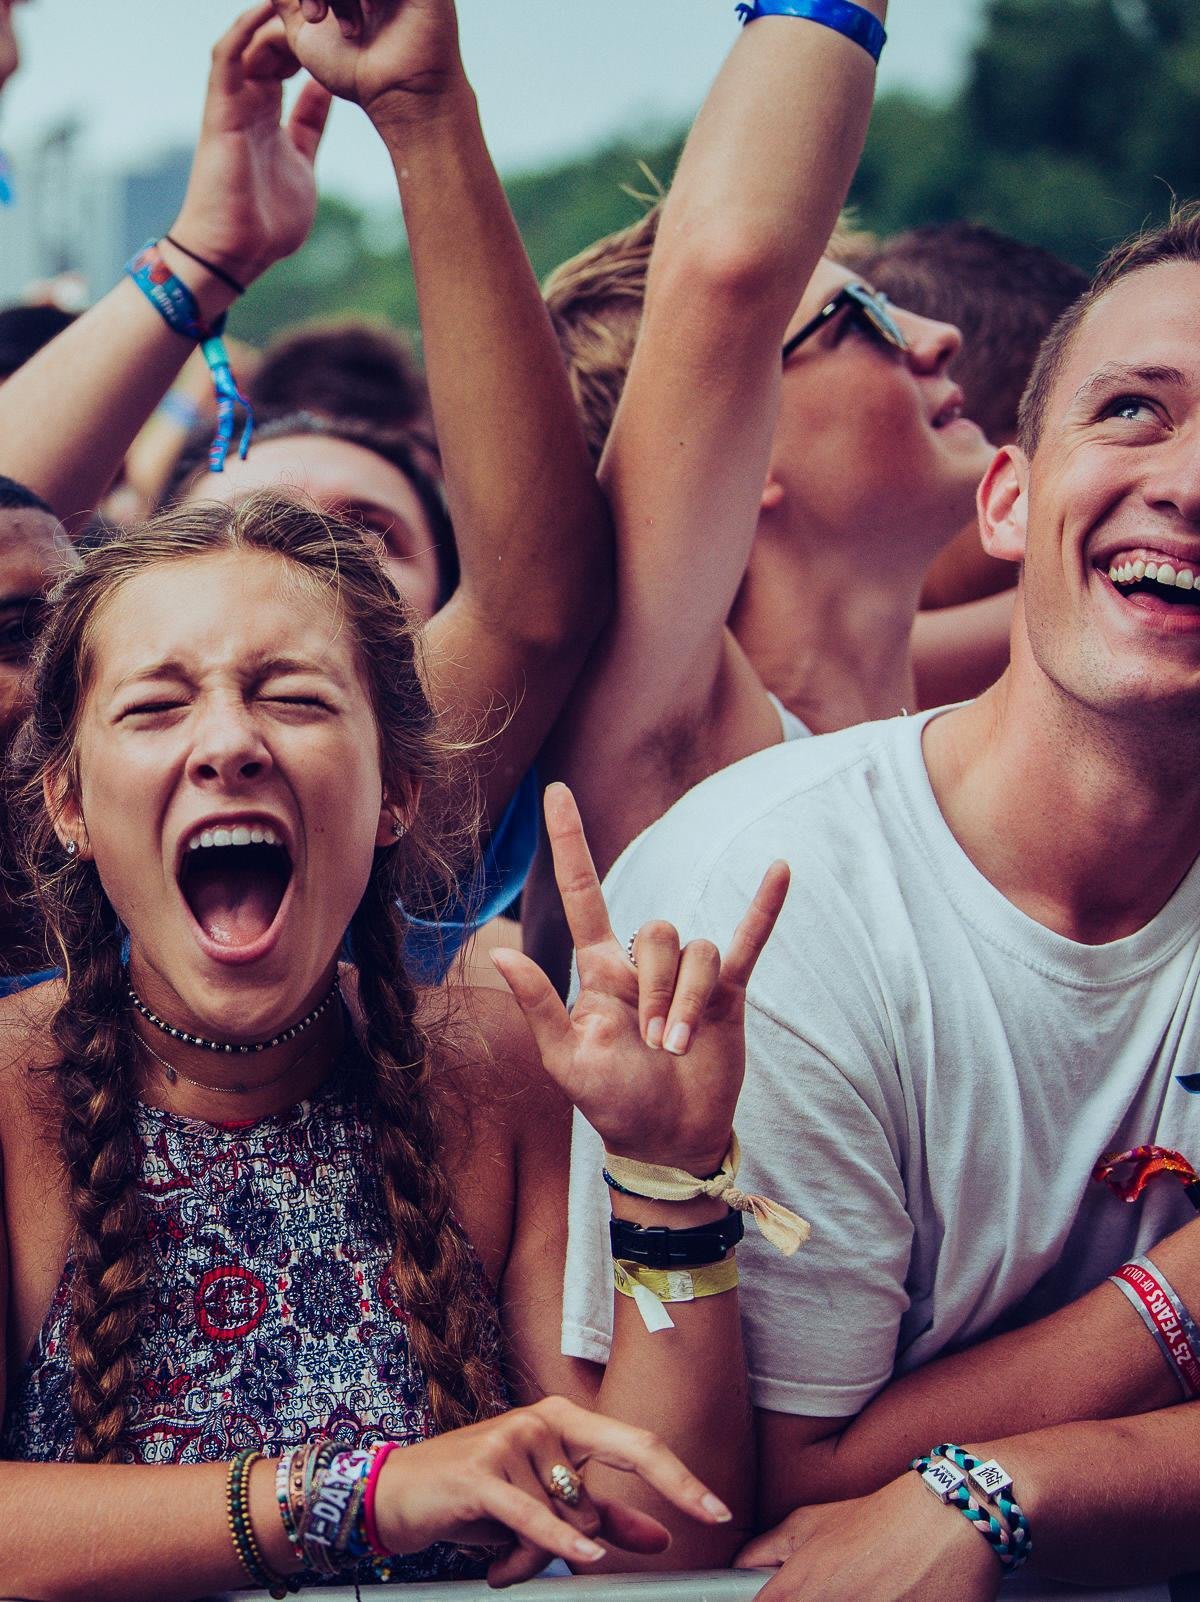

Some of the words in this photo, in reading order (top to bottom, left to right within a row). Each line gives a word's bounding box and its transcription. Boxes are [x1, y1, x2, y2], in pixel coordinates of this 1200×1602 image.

[1122, 1266, 1146, 1284] LOLLA
[1140, 1280, 1155, 1292] OF
[1146, 1289, 1182, 1344] YEARS
[1172, 1342, 1192, 1365] 25
